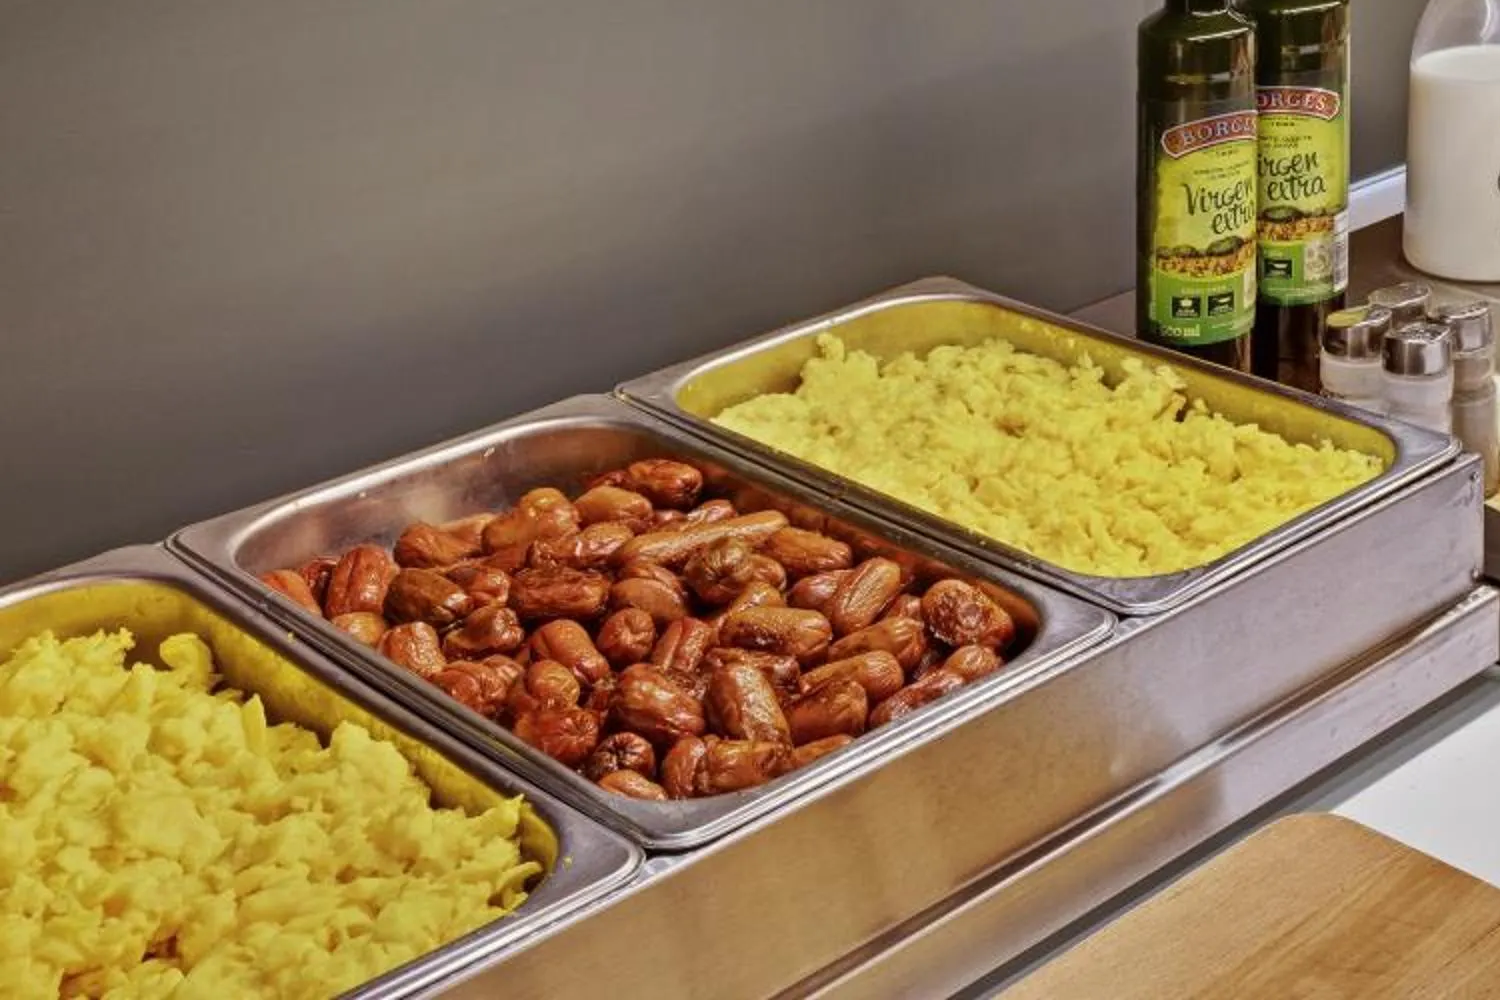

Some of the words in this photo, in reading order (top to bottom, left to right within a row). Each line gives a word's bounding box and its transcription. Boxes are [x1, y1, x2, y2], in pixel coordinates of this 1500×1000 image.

[1258, 93, 1326, 111] ORGES
[1257, 152, 1319, 177] irgen
[1267, 176, 1326, 201] extra
